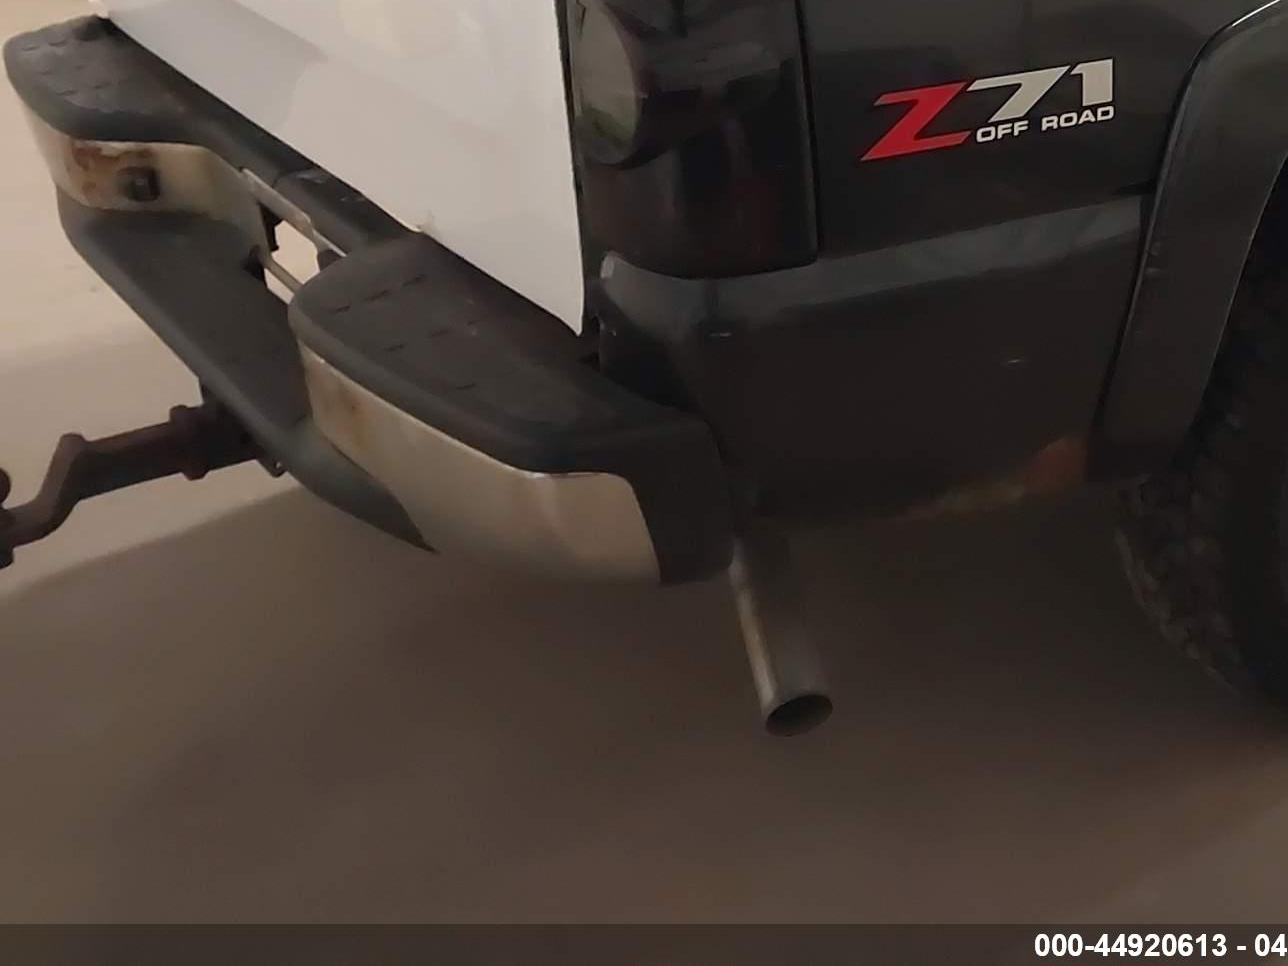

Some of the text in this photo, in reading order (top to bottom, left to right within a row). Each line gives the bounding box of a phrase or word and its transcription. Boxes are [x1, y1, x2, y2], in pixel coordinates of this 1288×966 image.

[860, 58, 1114, 162] Z71
[975, 105, 1115, 143] OFF ROAD
